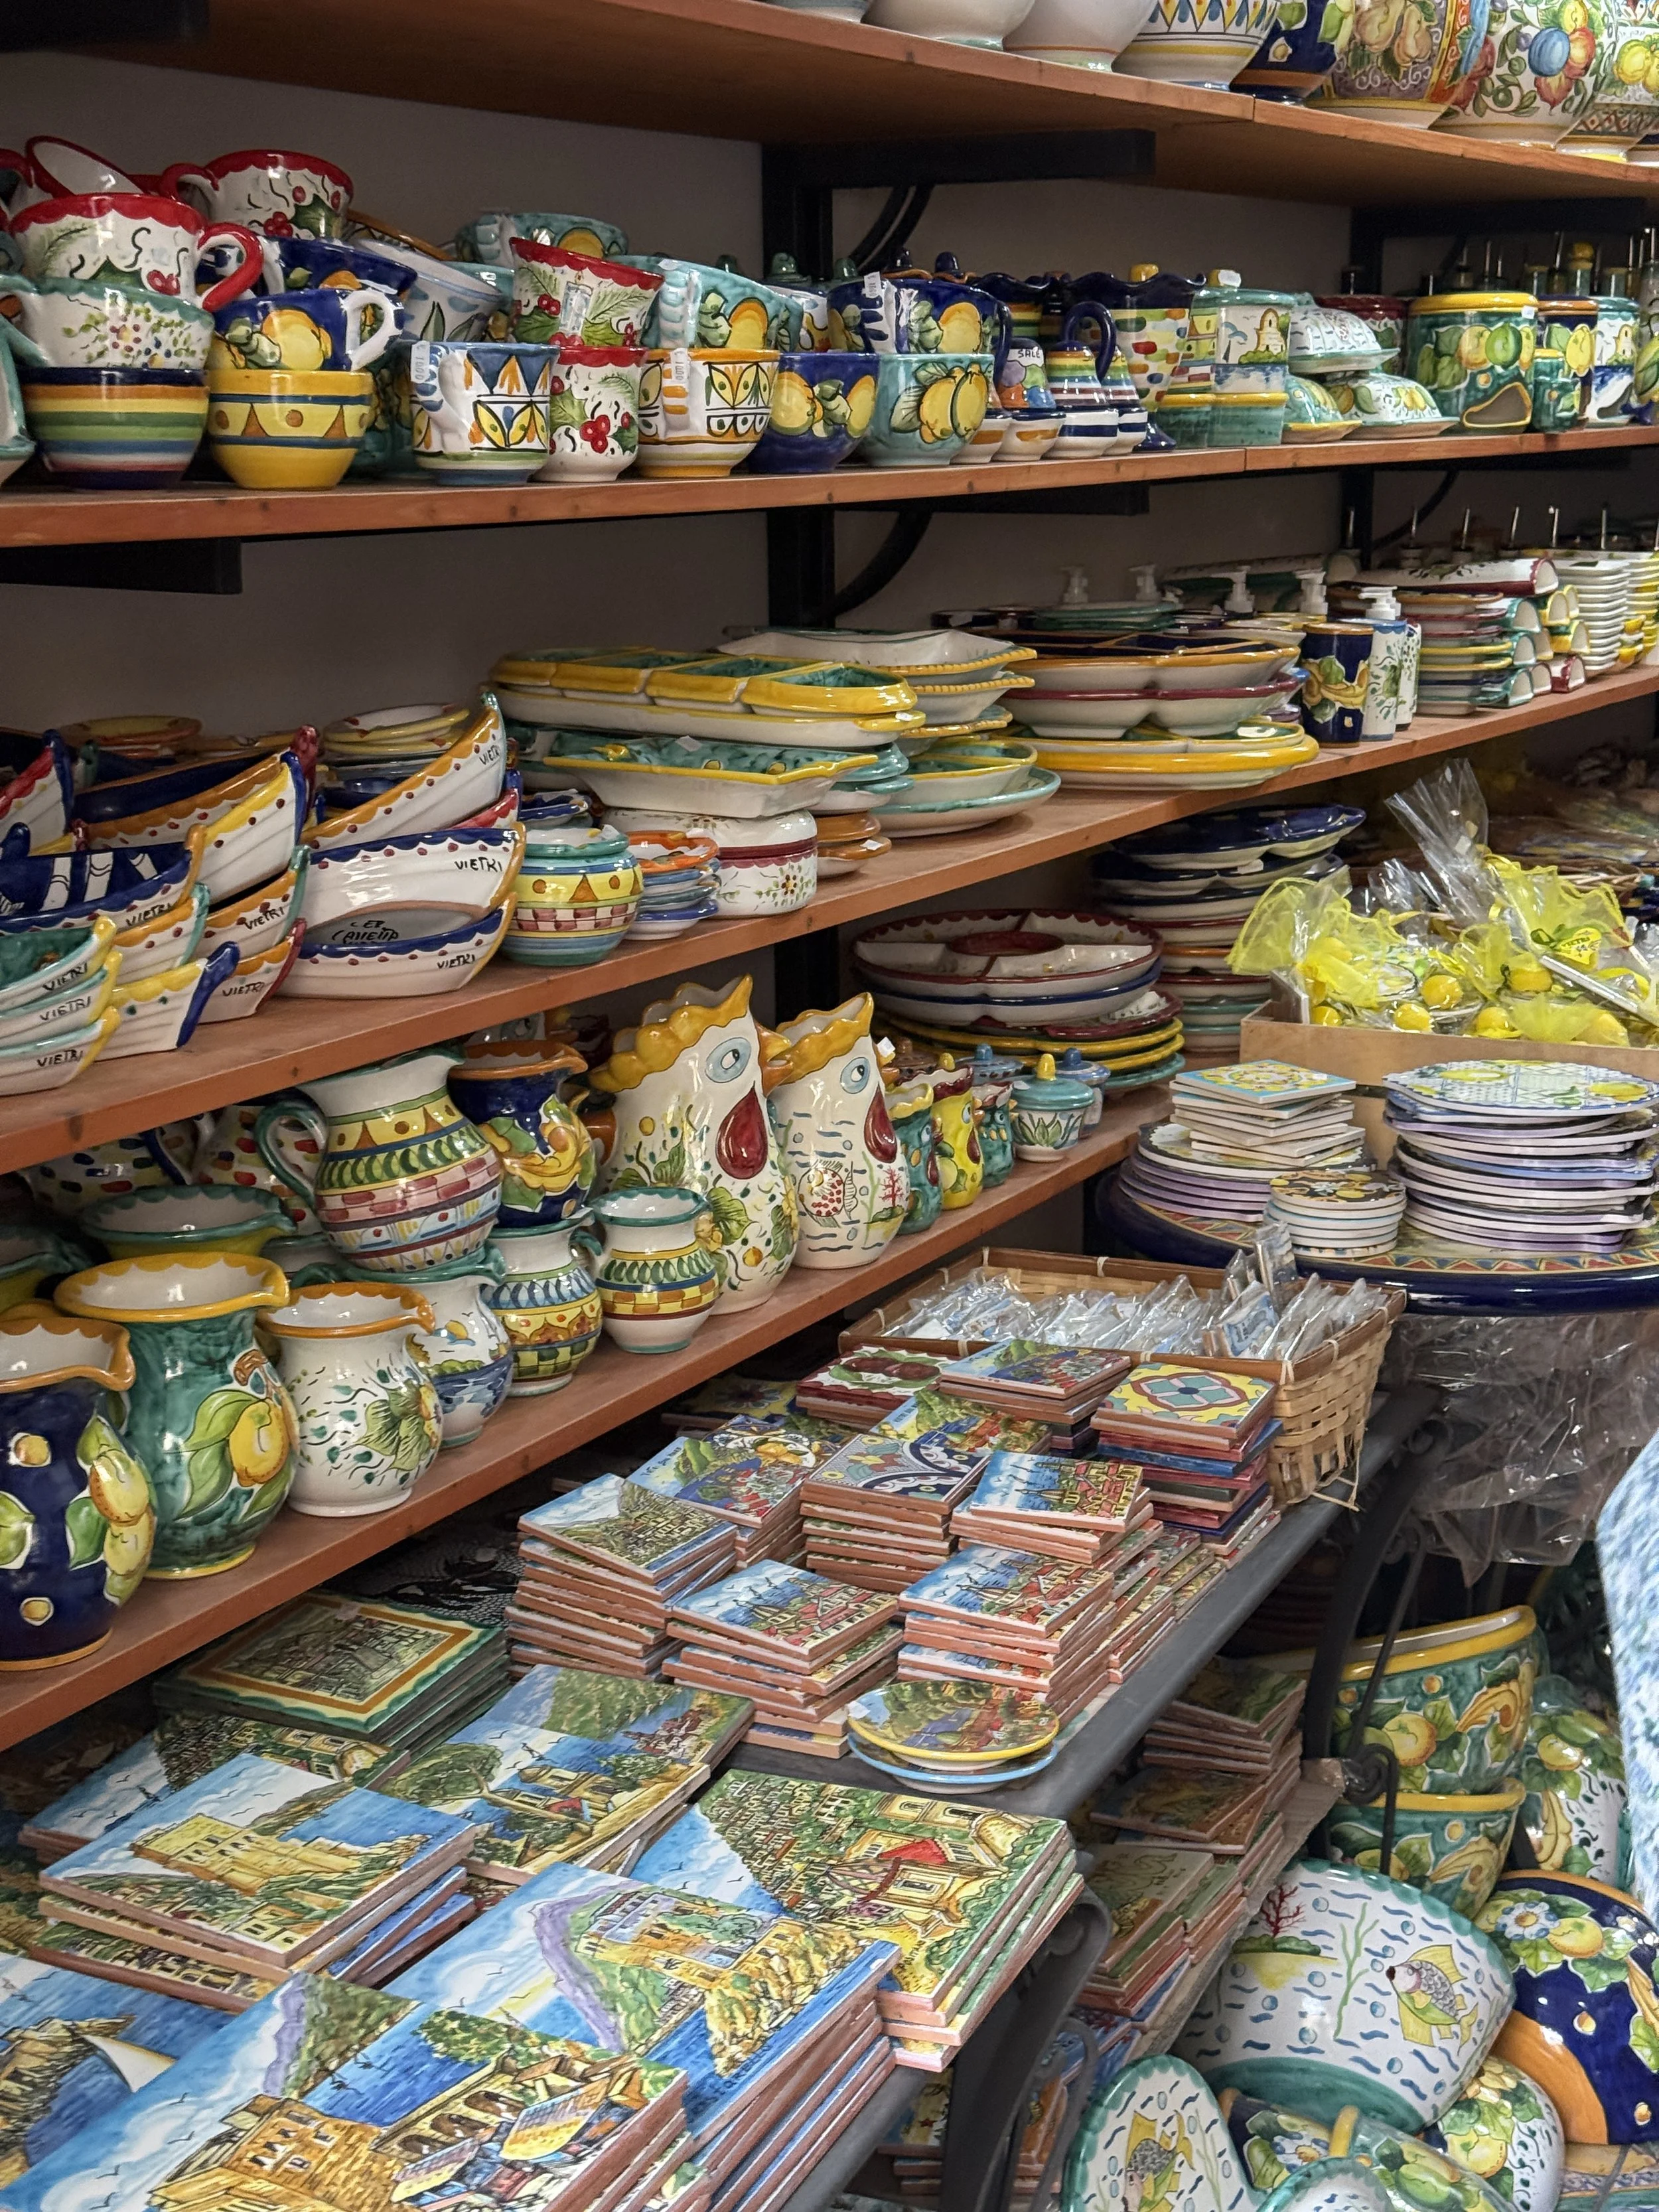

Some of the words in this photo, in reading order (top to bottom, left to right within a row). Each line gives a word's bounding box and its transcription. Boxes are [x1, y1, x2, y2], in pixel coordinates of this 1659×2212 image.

[1018, 349, 1041, 358] SALE
[479, 745, 500, 765] VIETR
[454, 856, 502, 872] VIETRI
[244, 907, 285, 930] VIETRI
[437, 954, 476, 969] VIETRI
[42, 962, 88, 991] VIETRI
[222, 981, 265, 997] VIETRI
[39, 996, 91, 1021] VIETRI
[36, 1049, 84, 1067] VIETRI
